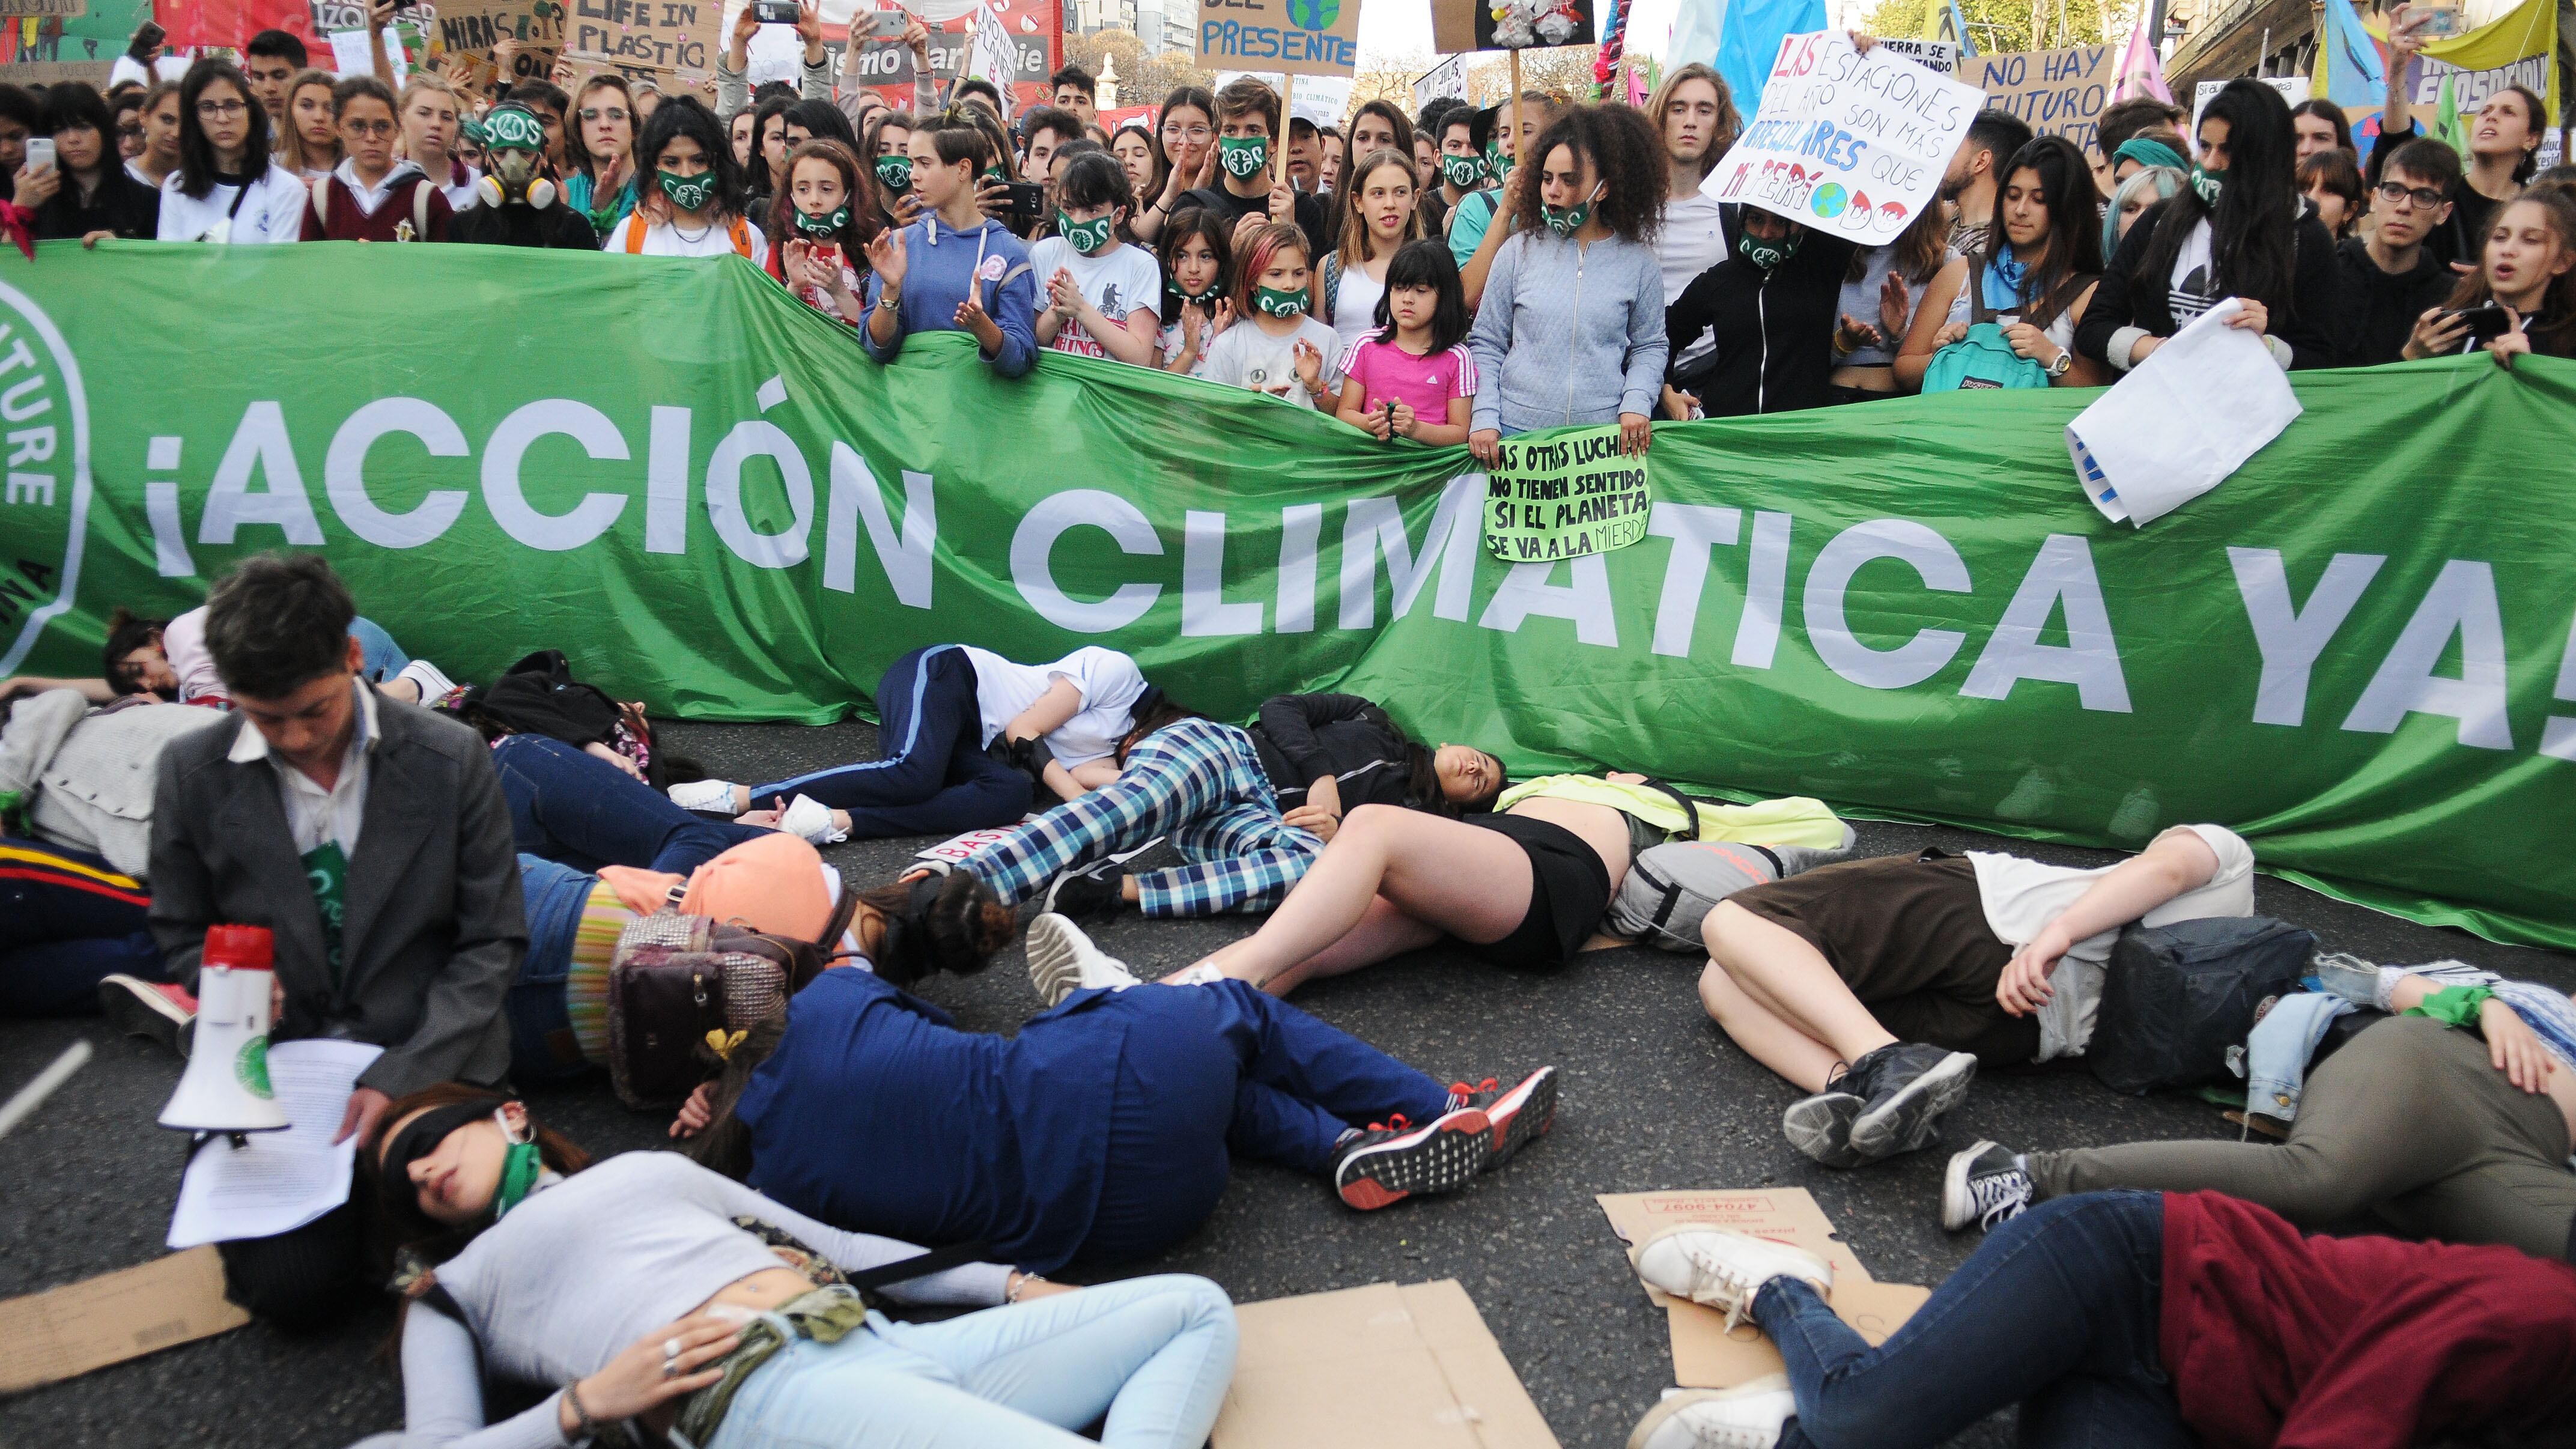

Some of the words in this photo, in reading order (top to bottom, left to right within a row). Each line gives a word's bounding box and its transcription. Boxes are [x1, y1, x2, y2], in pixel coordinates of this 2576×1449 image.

[659, 3, 697, 27] IN
[982, 6, 1000, 40] NO
[578, 24, 705, 68] PLASTIC
[1202, 19, 1356, 66] PRESENTE
[1928, 45, 1946, 59] SE
[1773, 34, 1823, 77] LAS
[1818, 40, 1961, 132] ESTACIONES
[1982, 56, 2027, 89] NO
[2043, 46, 2106, 82] HAY
[1759, 82, 1789, 115] DEL
[1803, 83, 1835, 112] AÑO
[1844, 104, 1889, 138] SON
[1897, 126, 1944, 158] MÁS
[1985, 84, 2105, 122] FUTURO
[1743, 120, 1868, 172] IRREGULARES
[1871, 155, 1925, 192] QUE
[1491, 445, 1519, 472] AS
[1526, 441, 1569, 472] OTRAS
[1573, 433, 1634, 466] LUCH
[145, 374, 937, 609] ¡ACCIÓN
[1488, 475, 1511, 497] NO
[1516, 476, 1569, 500] TIENEN
[1574, 469, 1645, 496] SENTIDO
[1495, 500, 1516, 529] SI
[1524, 505, 1546, 530] EL
[1555, 490, 1648, 529] PLANETA
[1486, 534, 1509, 556] SE
[1514, 537, 1542, 559] VA
[1546, 538, 1560, 559] A
[1563, 532, 1593, 555] LA
[1663, 1203, 1757, 1212] 4704-9097
